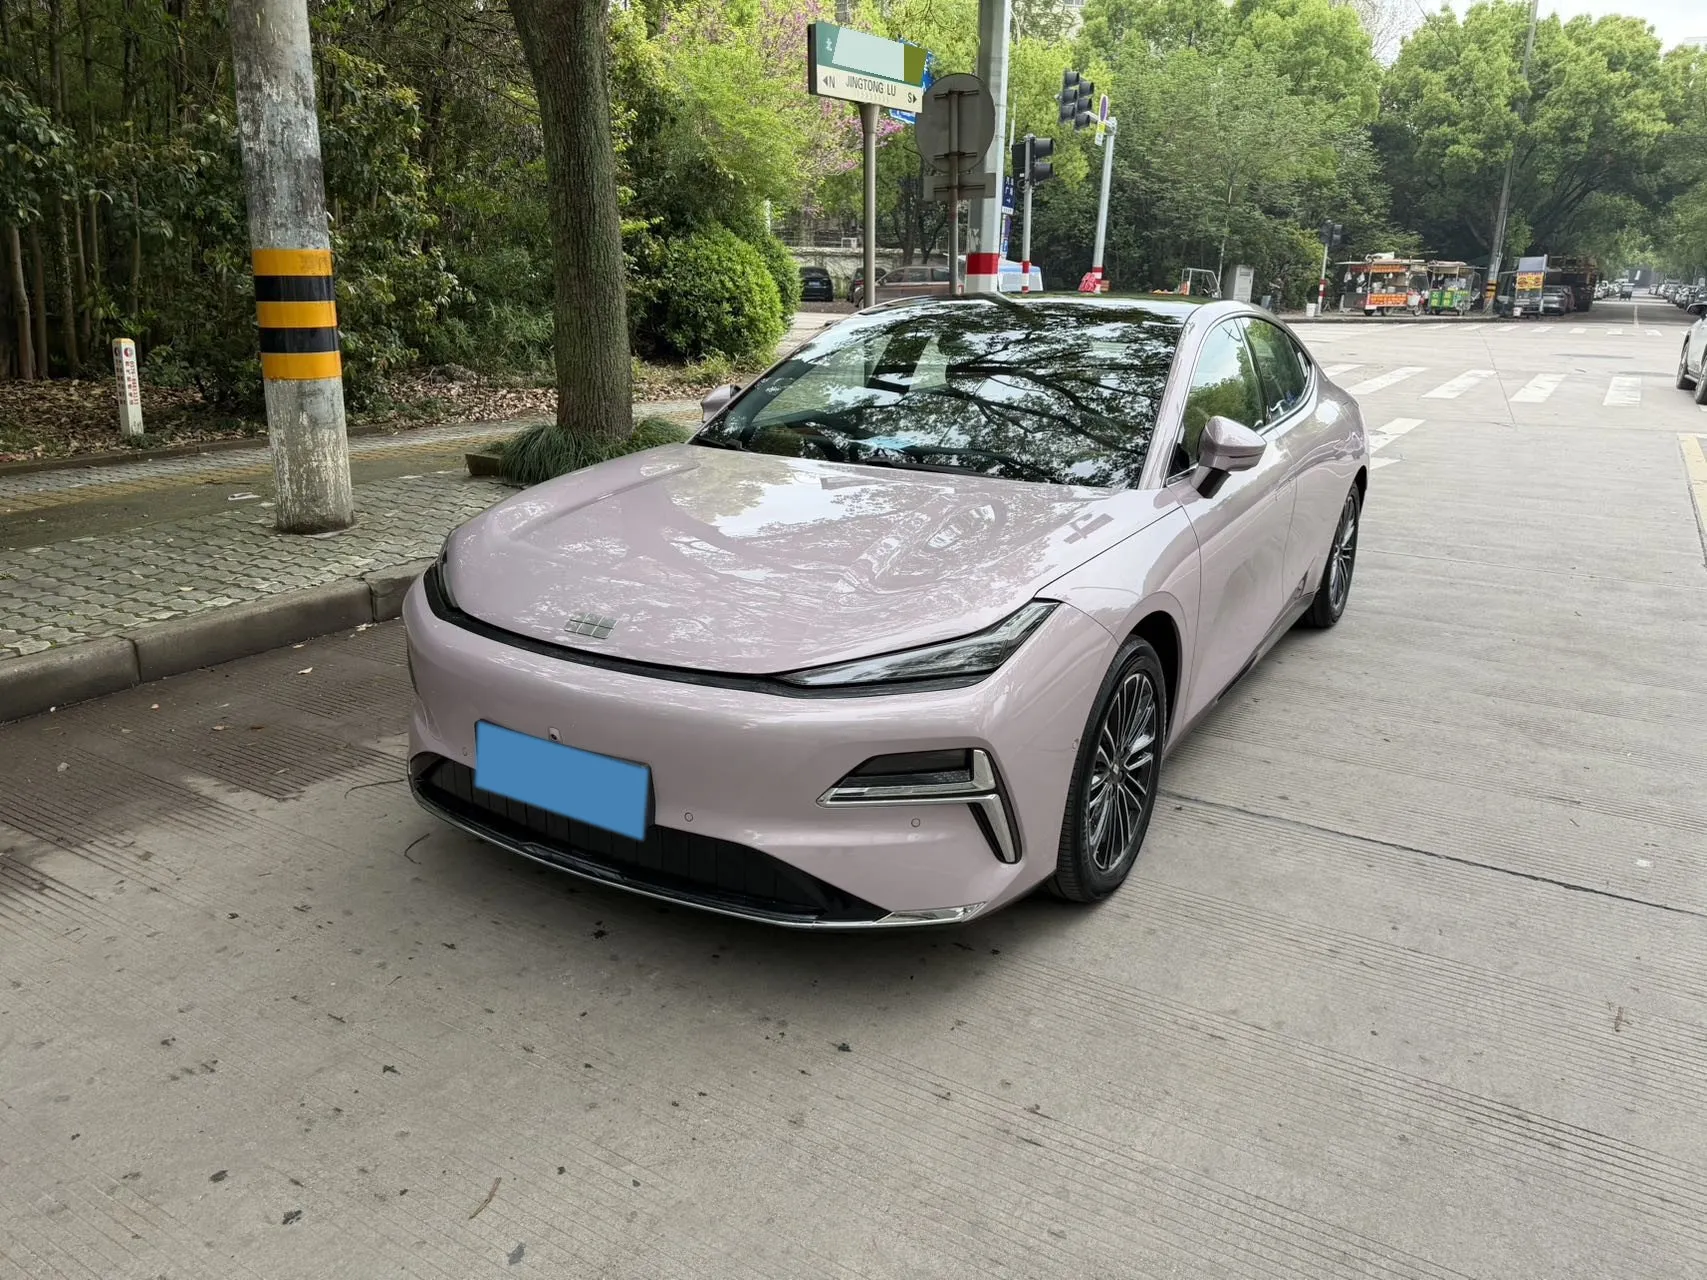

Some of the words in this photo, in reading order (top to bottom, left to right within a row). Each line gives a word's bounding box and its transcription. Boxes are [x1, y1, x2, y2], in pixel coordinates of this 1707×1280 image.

[829, 75, 835, 88] N
[846, 75, 884, 94] JINGTONG
[886, 84, 896, 96] LU
[907, 92, 912, 103] S
